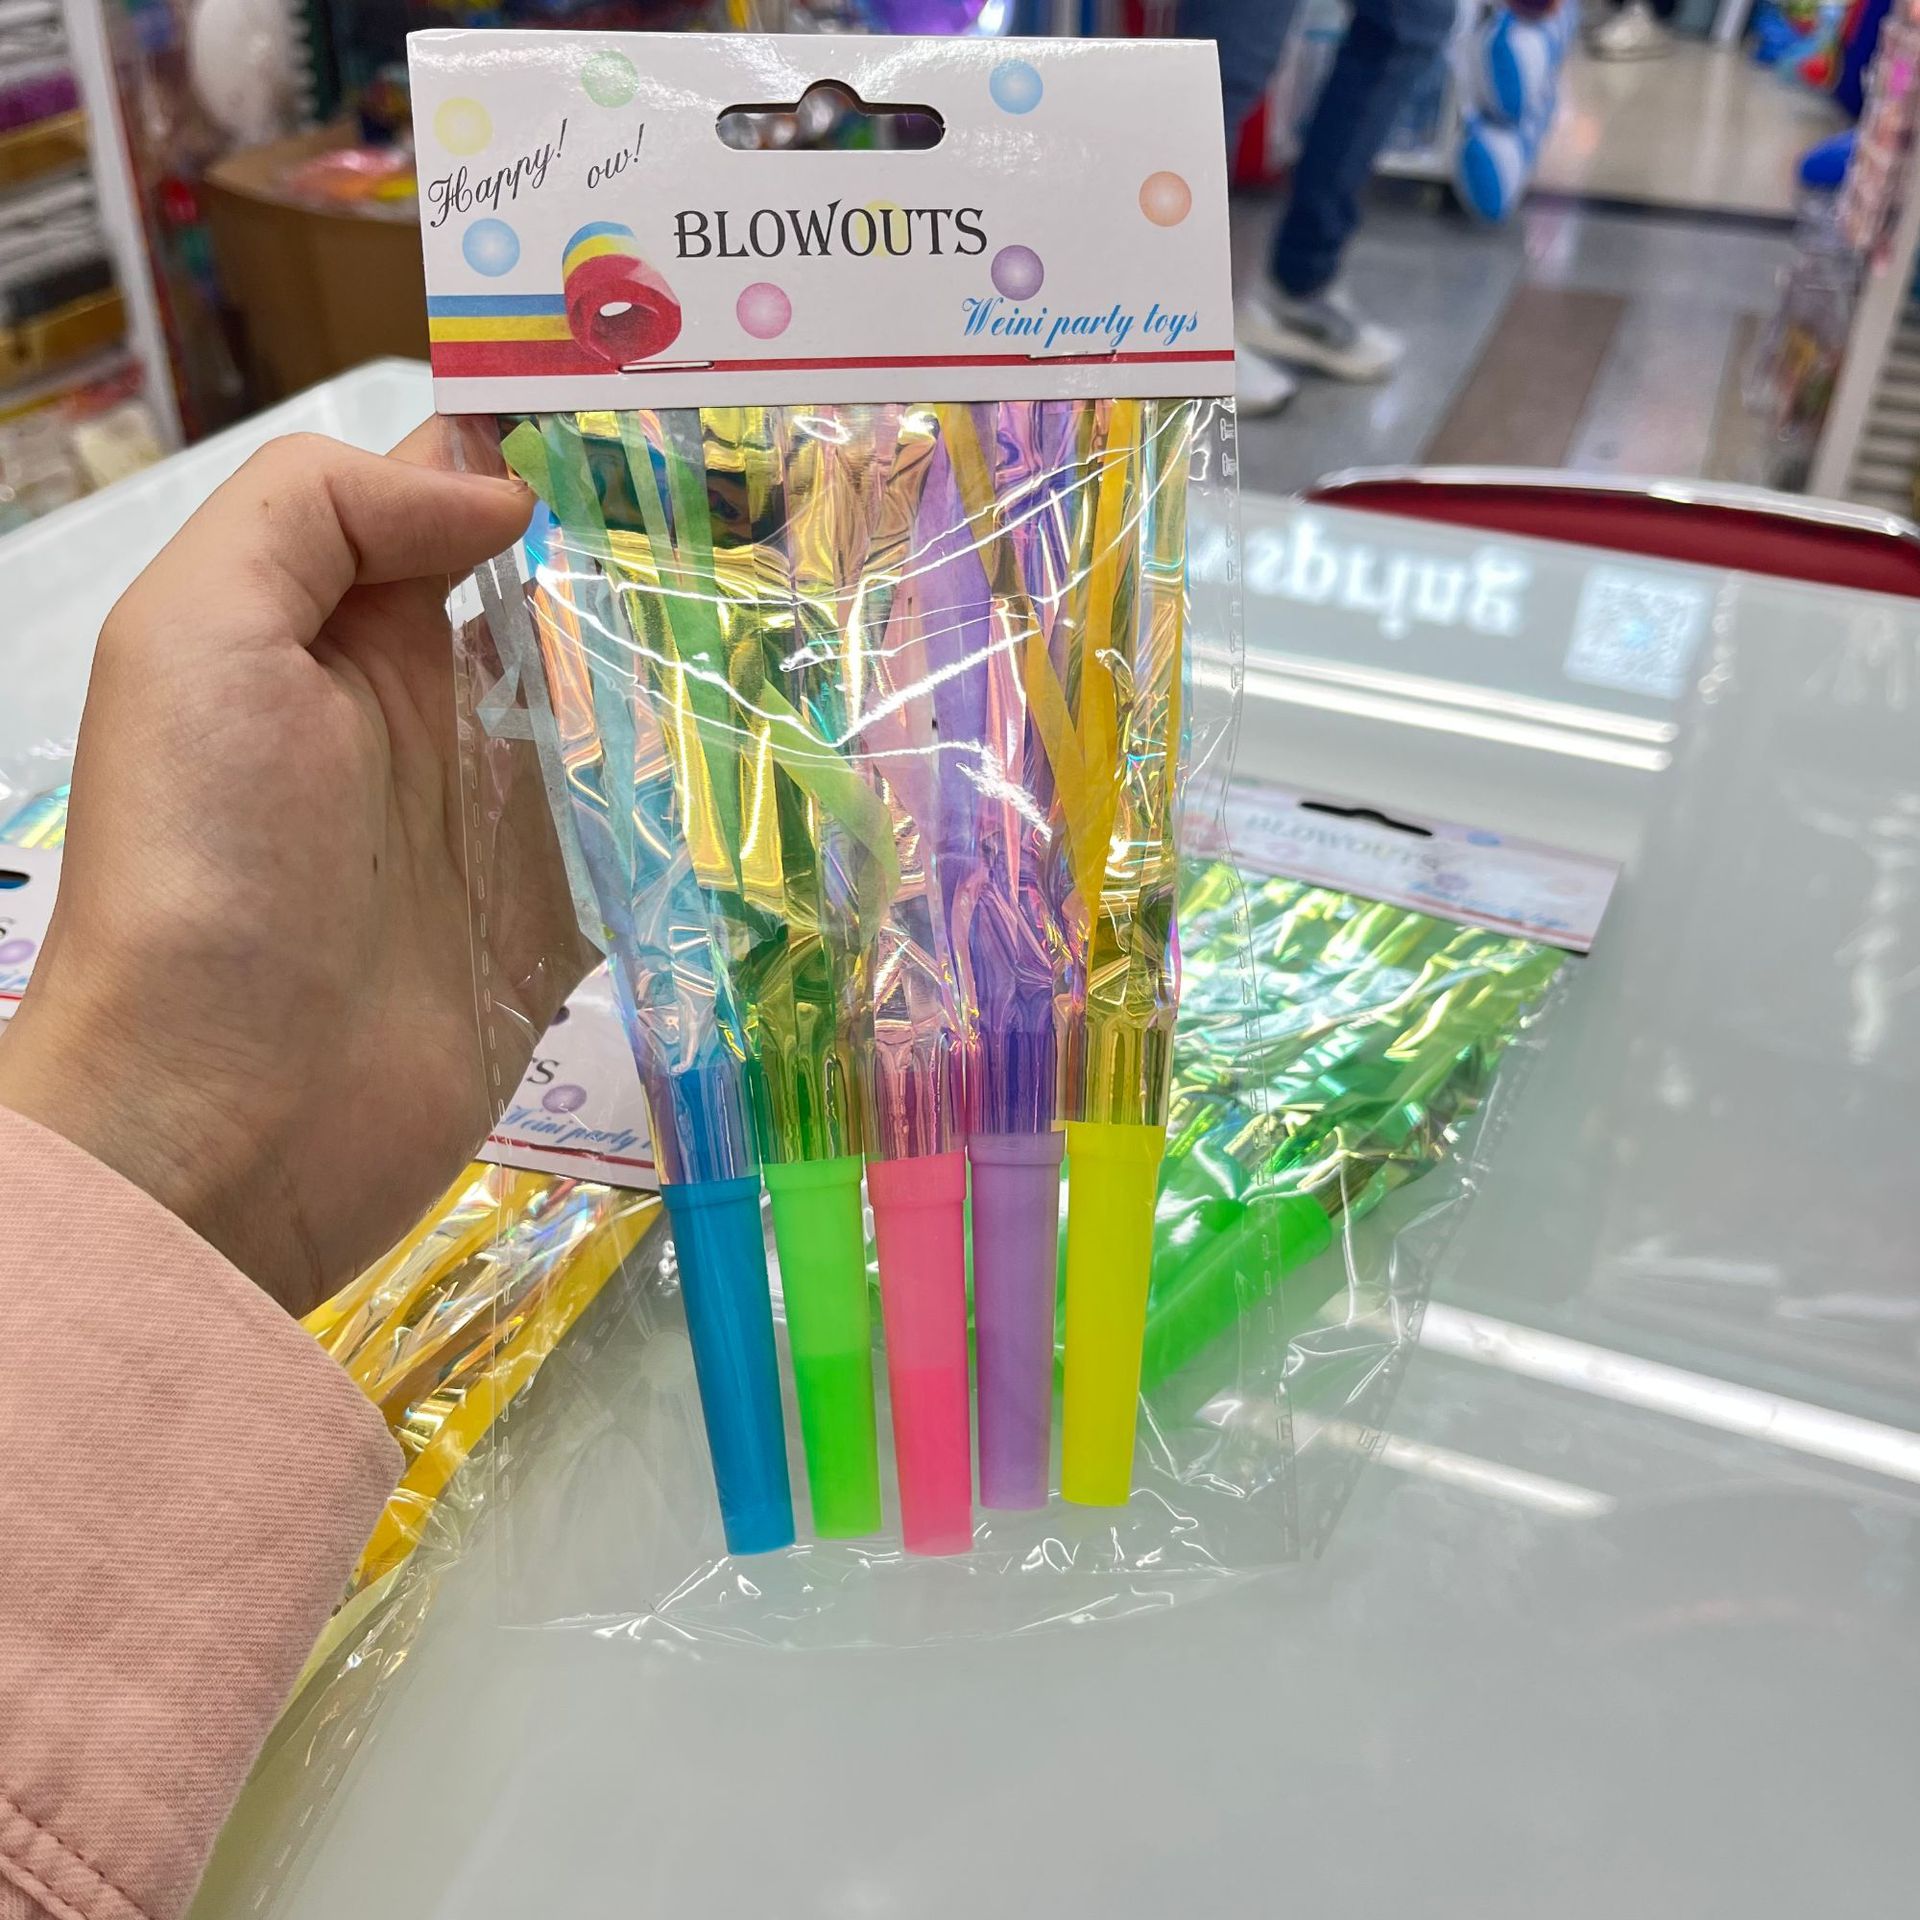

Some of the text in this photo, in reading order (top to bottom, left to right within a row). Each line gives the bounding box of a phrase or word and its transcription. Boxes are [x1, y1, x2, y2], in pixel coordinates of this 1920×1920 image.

[428, 118, 567, 227] Happy!
[587, 123, 645, 189] ow!
[673, 199, 988, 259] BLOWOUTS
[962, 297, 1199, 348] Weini party toys
